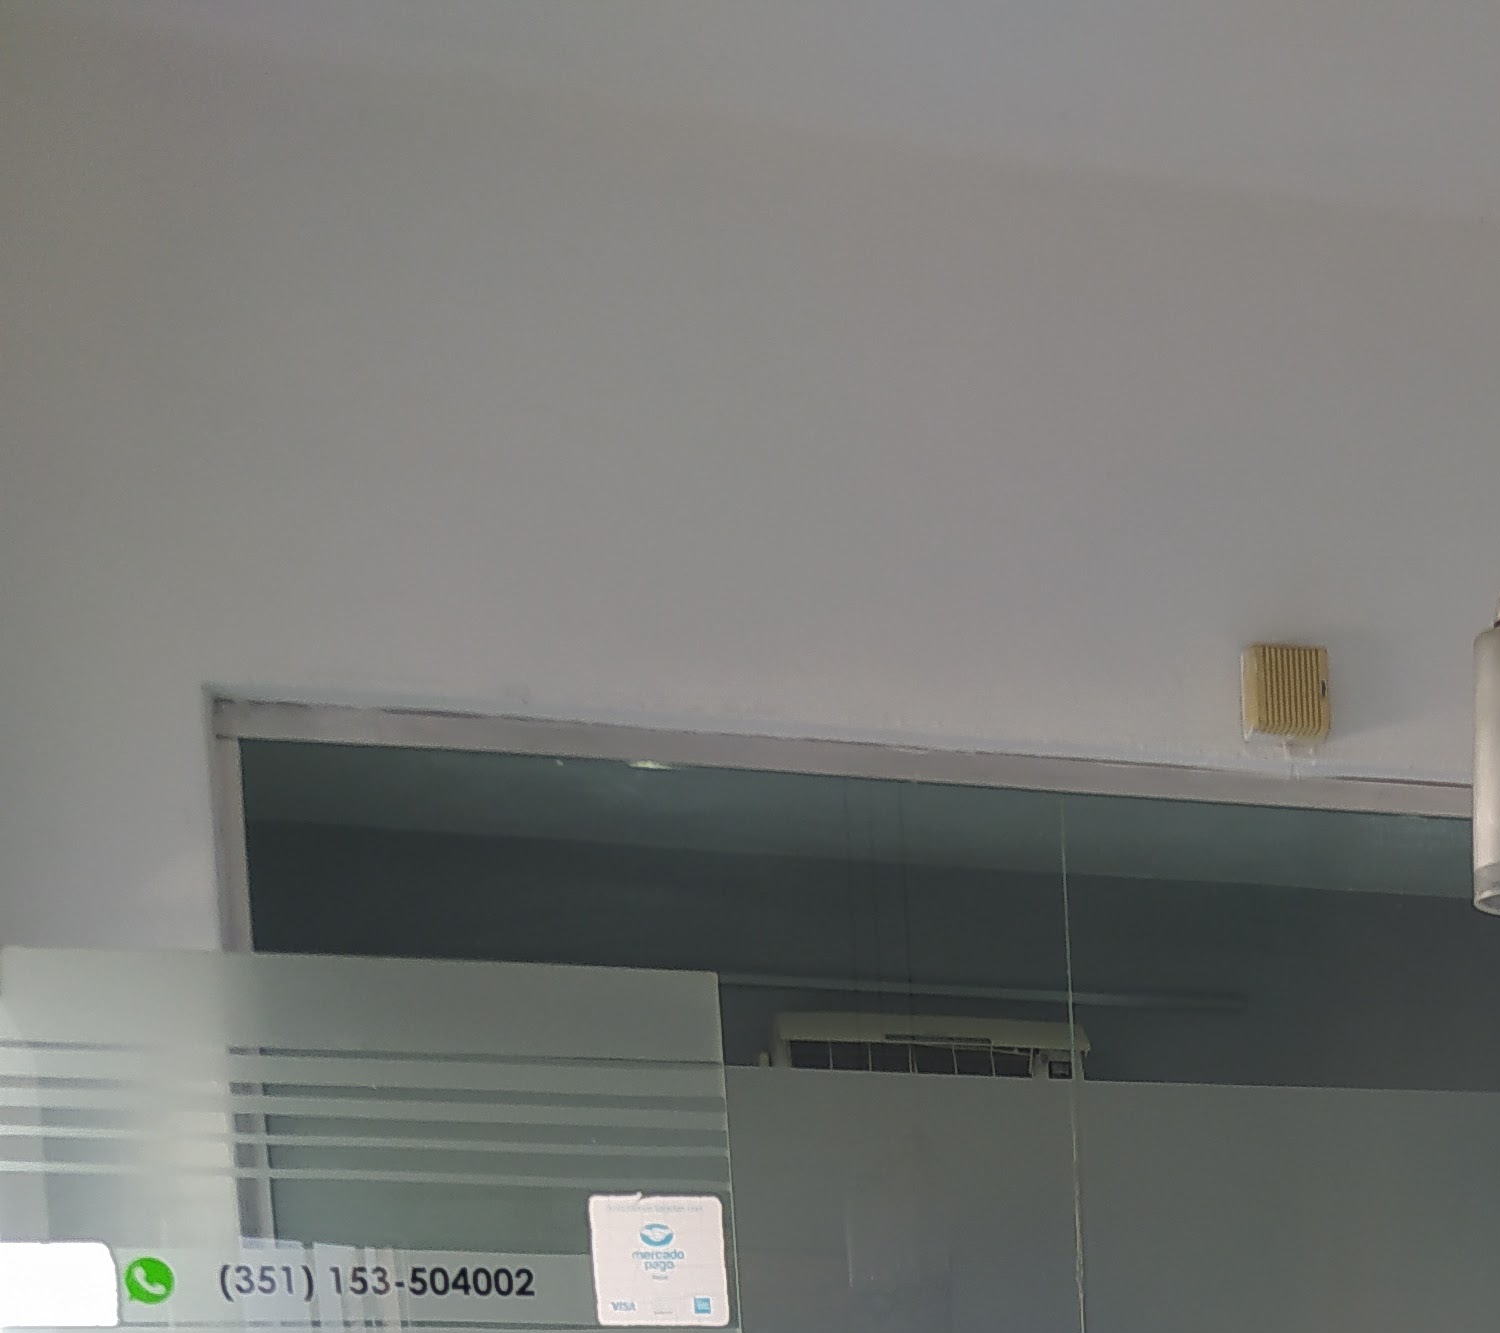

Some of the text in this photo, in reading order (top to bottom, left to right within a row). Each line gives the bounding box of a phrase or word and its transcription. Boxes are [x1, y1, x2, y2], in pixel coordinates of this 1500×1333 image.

[631, 1249, 685, 1260] mercado
[644, 1260, 675, 1272] pago
[219, 1264, 536, 1302] (351) 153-504002
